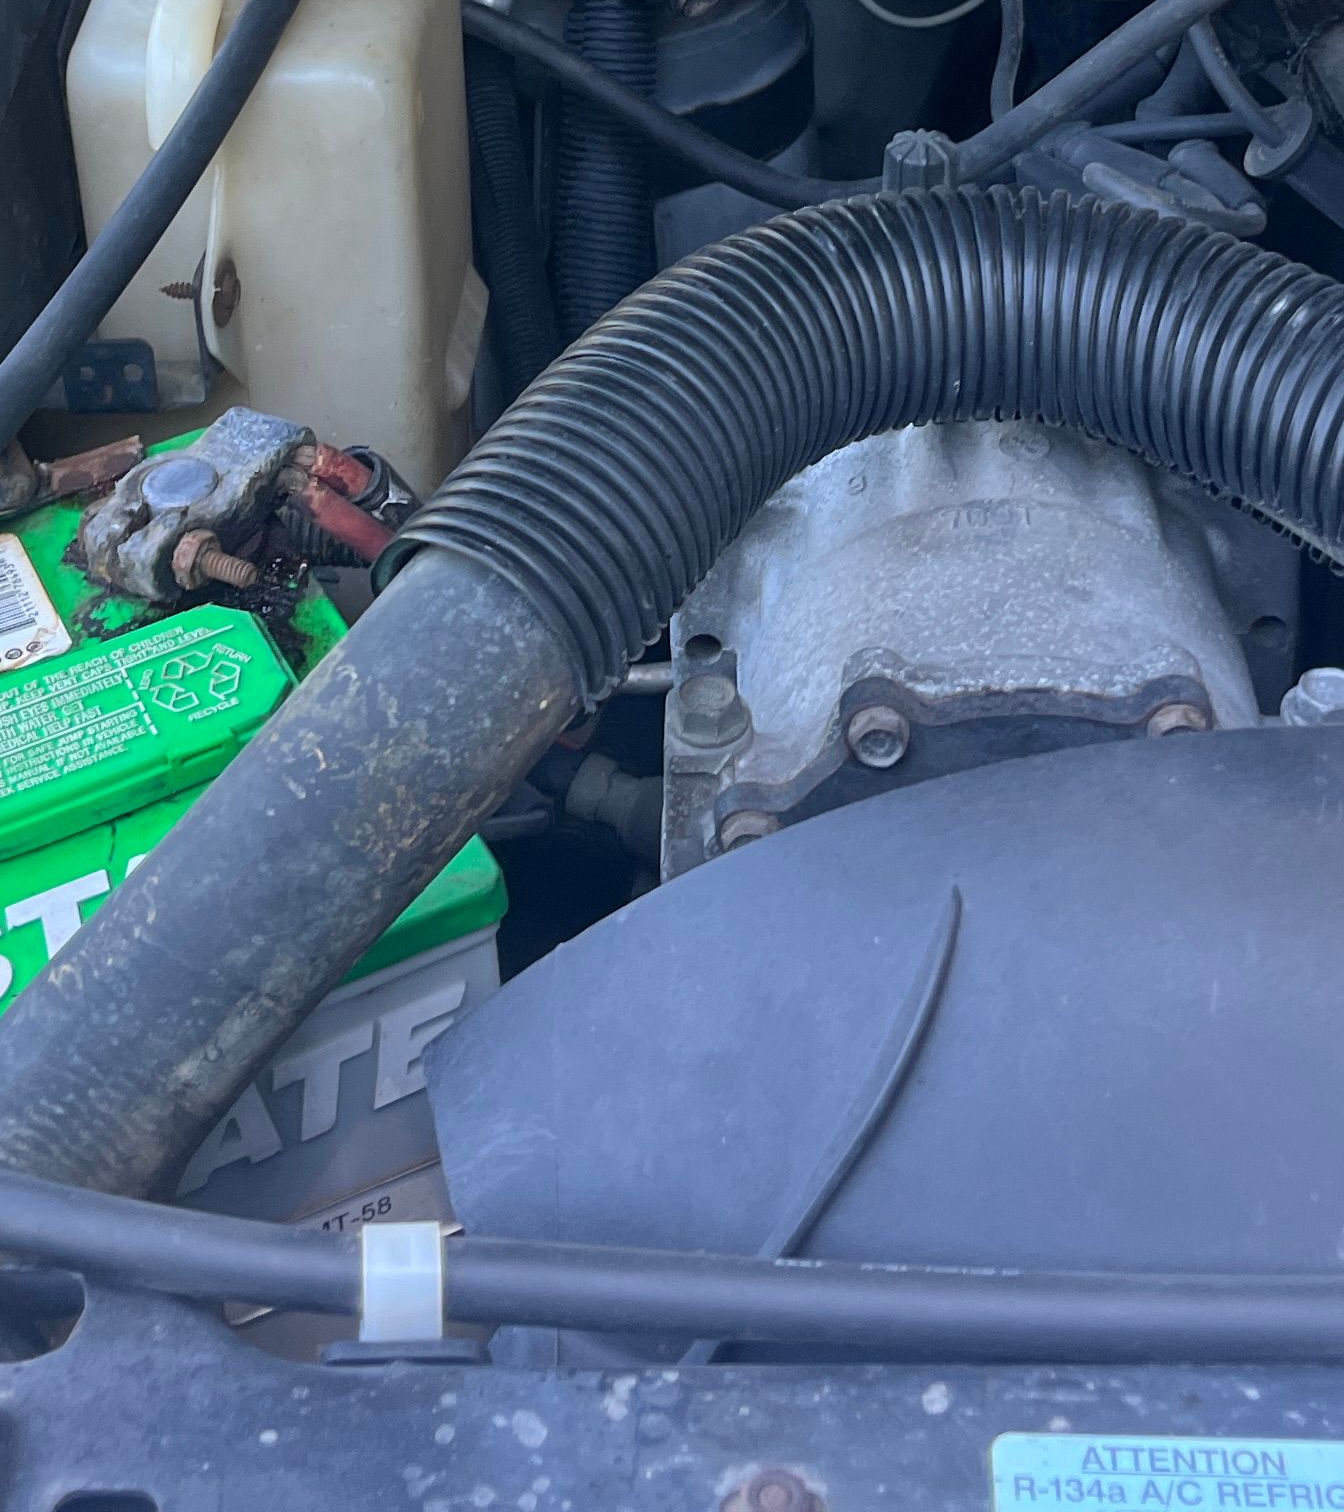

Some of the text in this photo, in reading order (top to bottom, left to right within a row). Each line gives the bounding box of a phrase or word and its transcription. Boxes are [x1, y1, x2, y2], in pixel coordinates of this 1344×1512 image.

[23, 678, 41, 695] OF
[44, 669, 66, 687] THE
[66, 654, 109, 680] REACH
[110, 646, 128, 664] OF
[128, 625, 186, 656] CHILDREN
[211, 642, 254, 665] RETURN
[14, 687, 47, 711] KEEP
[47, 677, 79, 698] VENT
[79, 664, 114, 687] CAPS
[116, 651, 149, 671] TIGHT
[149, 639, 175, 661] AND
[18, 701, 51, 725] EYES
[51, 670, 126, 712] IMMEDIATELY
[60, 699, 86, 719] GET
[187, 695, 242, 724] RECYCLE
[25, 741, 55, 762] SAFE
[55, 728, 85, 749] JUMP
[84, 707, 140, 739] STARTING
[43, 716, 74, 739] HELP
[73, 704, 104, 726] FAST
[5, 739, 83, 777] INSTRUCTIONS
[82, 734, 97, 751] IN
[97, 717, 140, 744] VEHICLE
[67, 746, 92, 766] NOT
[92, 724, 149, 757] AVAILABLE
[17, 769, 61, 795] SERVICE
[1082, 1445, 1288, 1478] ATTENTION
[1014, 1475, 1127, 1505] R-134a
[1141, 1479, 1203, 1509] A/C
